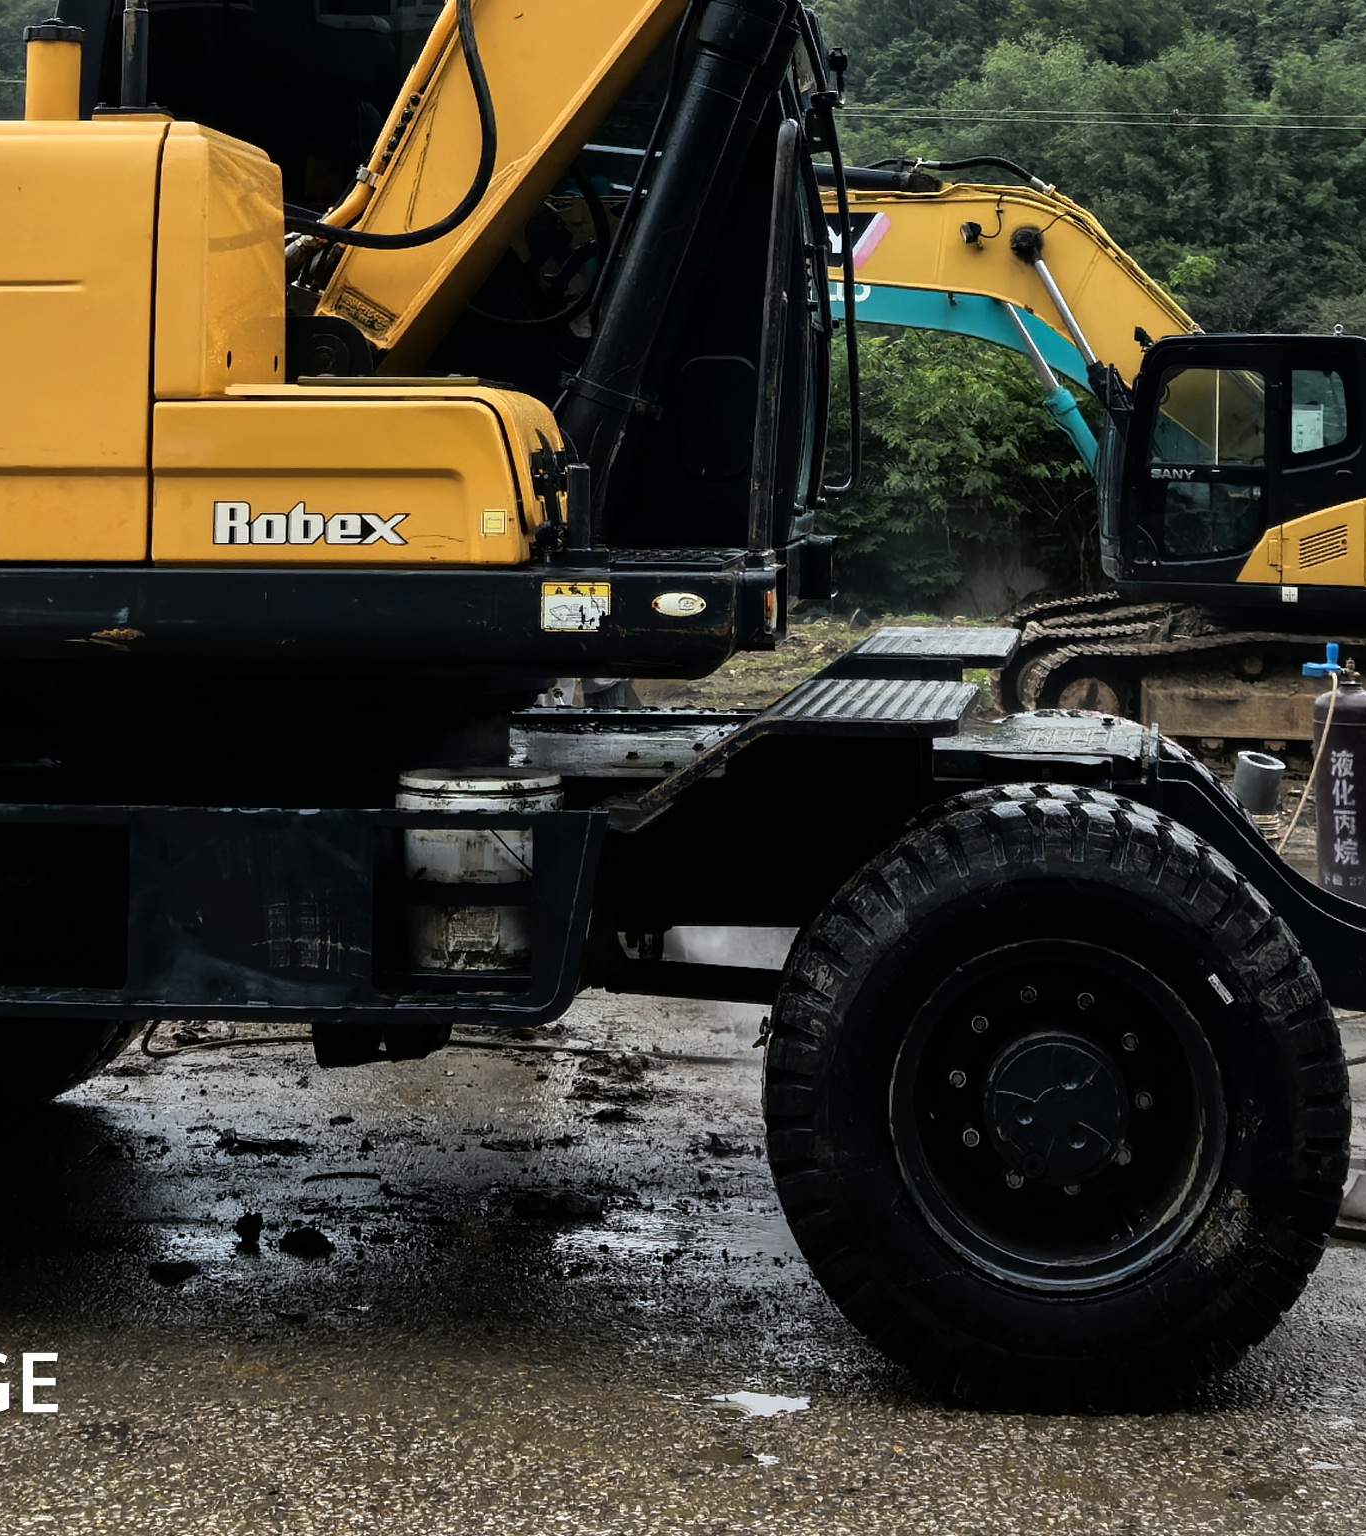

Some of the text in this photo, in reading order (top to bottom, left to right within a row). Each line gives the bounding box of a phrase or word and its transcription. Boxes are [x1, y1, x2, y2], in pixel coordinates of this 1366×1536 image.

[1150, 468, 1195, 480] SANY
[213, 501, 409, 545] Robex
[1331, 750, 1359, 864] 液化丙烷
